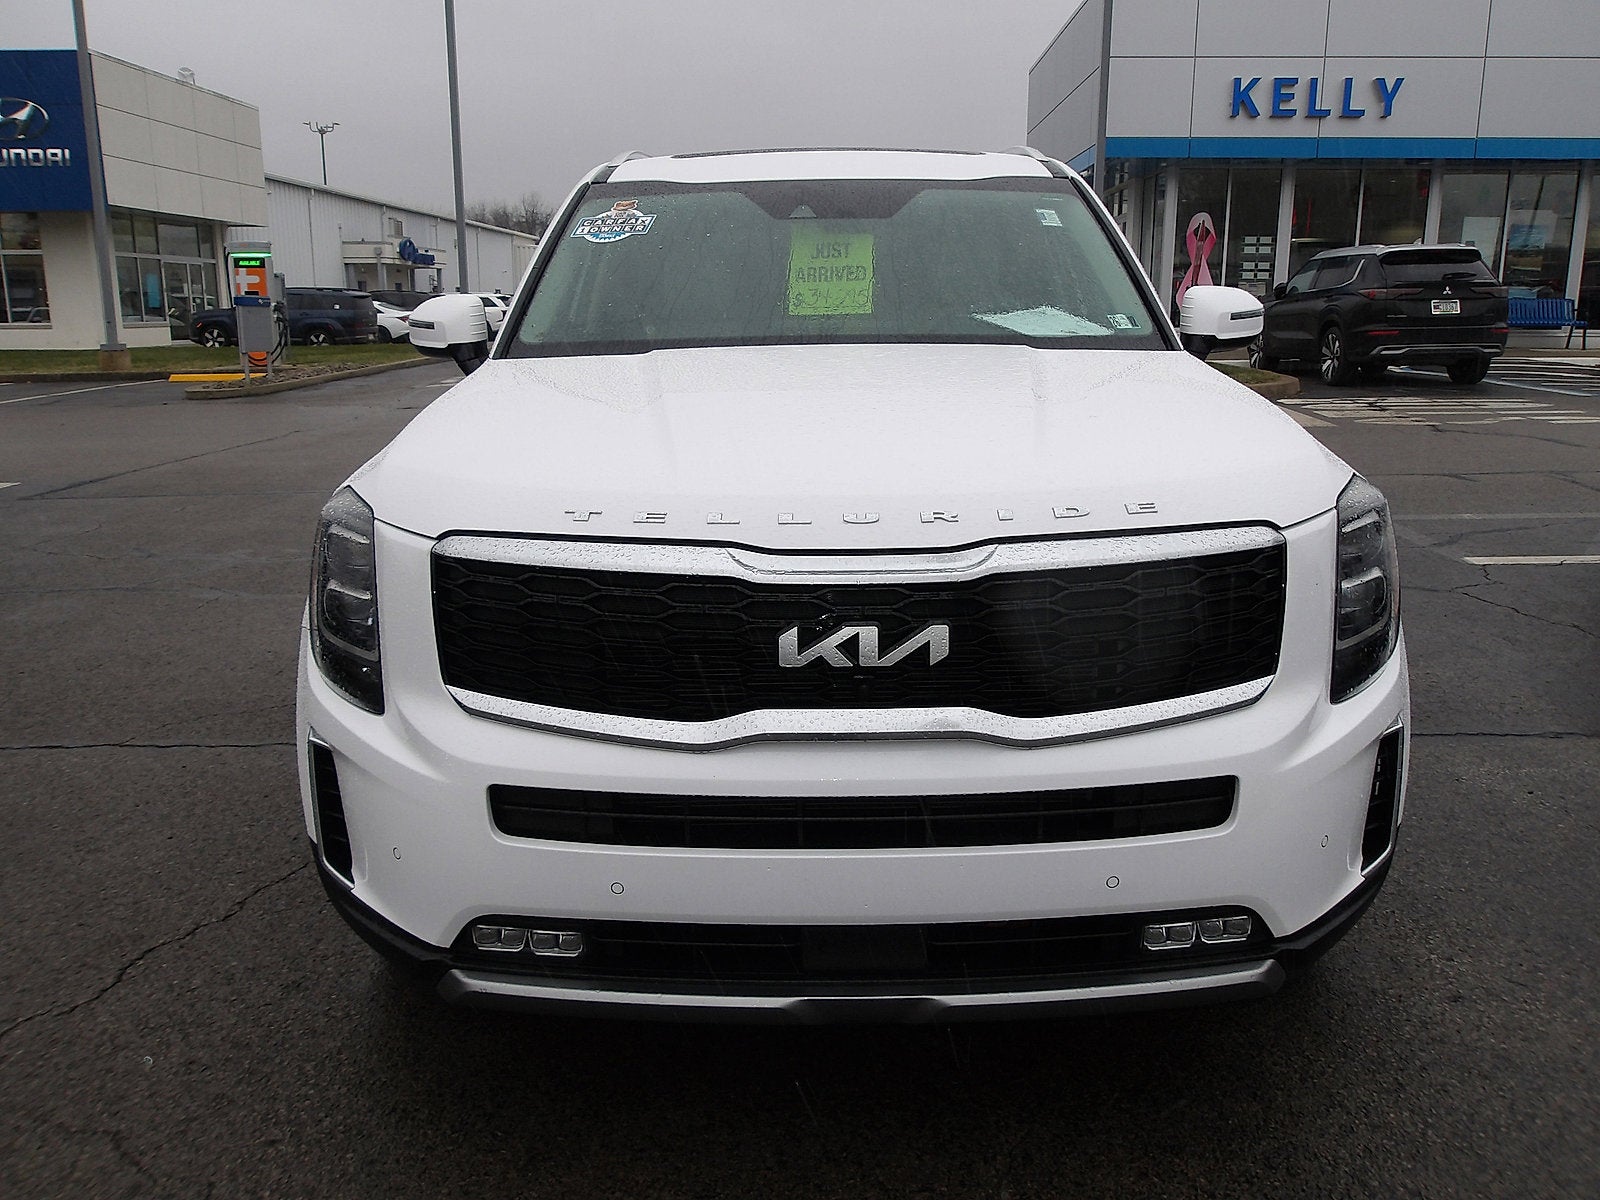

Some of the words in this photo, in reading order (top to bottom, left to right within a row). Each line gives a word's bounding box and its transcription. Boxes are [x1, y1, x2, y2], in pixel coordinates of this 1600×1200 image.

[1230, 76, 1405, 118] KELLY
[583, 216, 650, 227] CARFAX
[589, 224, 645, 233] OWNER
[810, 241, 849, 260] JUST
[796, 265, 867, 283] ARRIVED
[564, 499, 1160, 525] TELLURIDE
[778, 624, 950, 668] KIA
